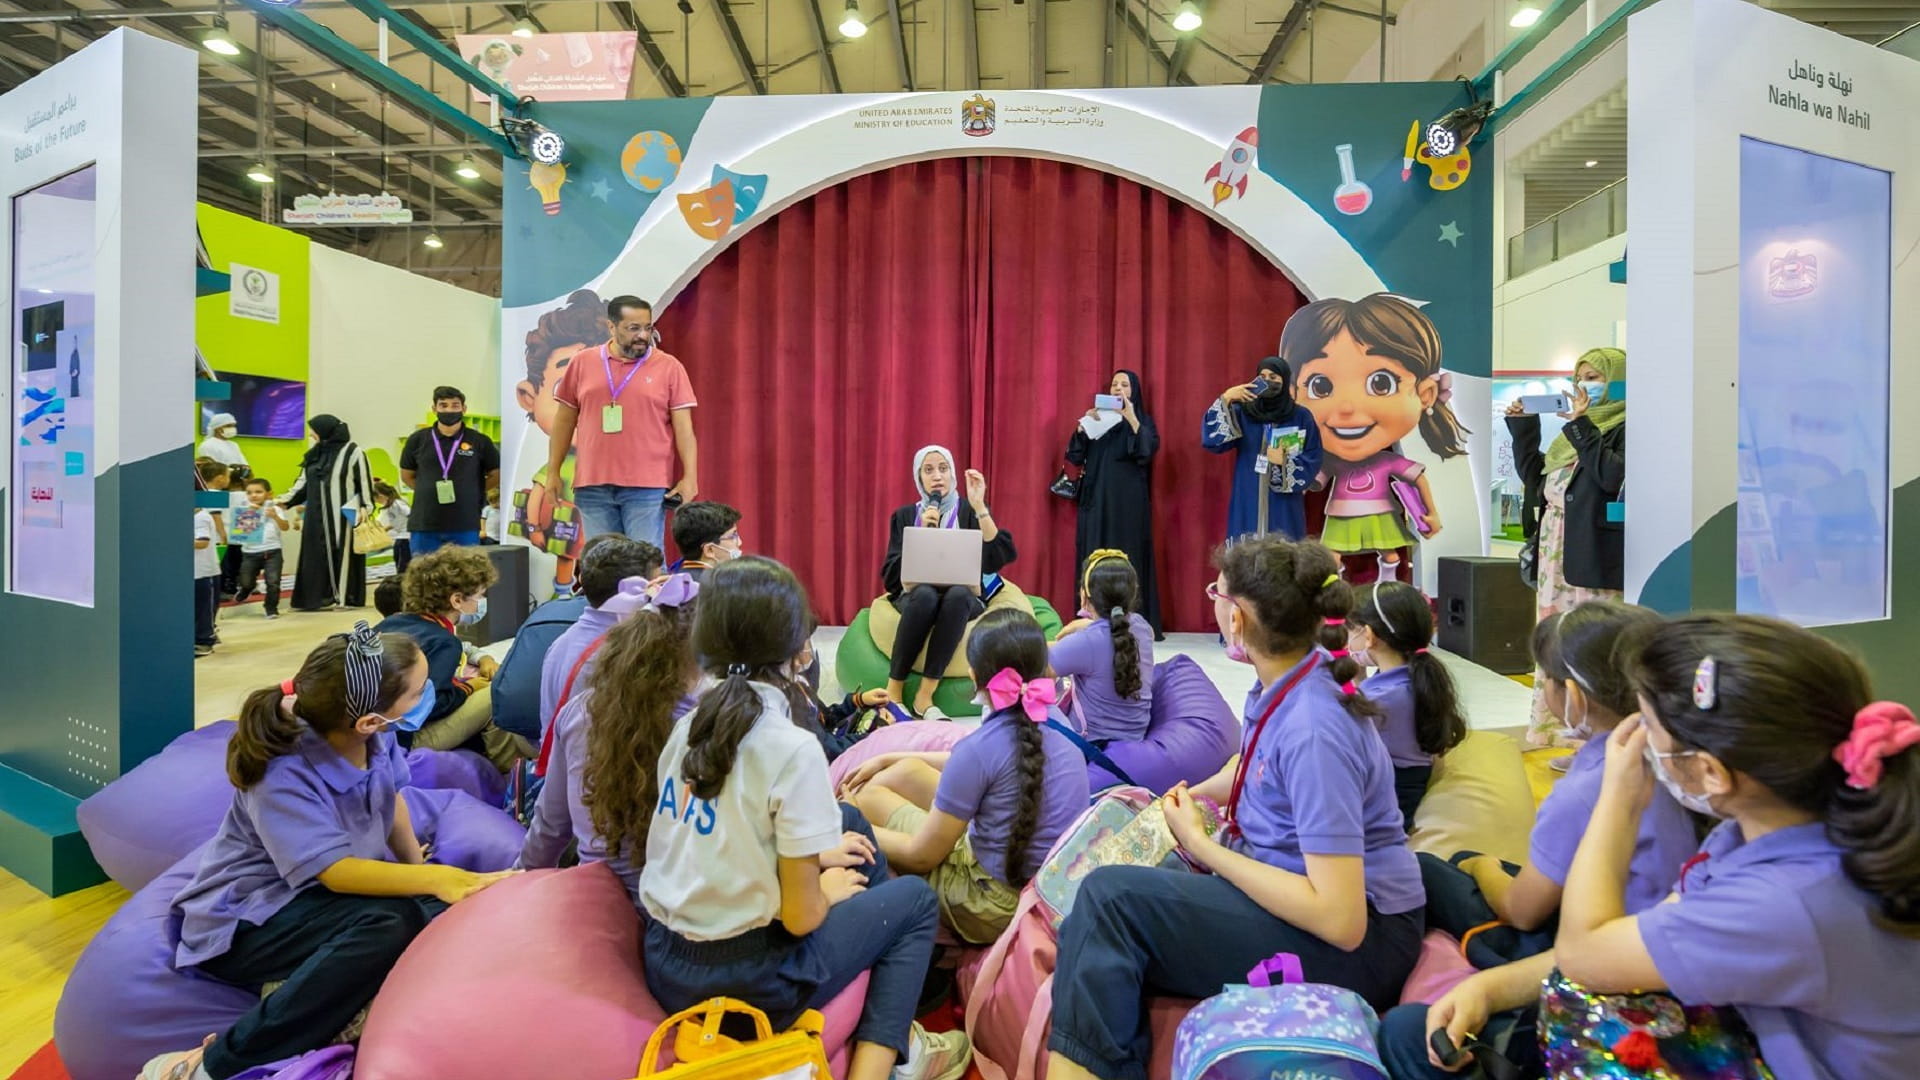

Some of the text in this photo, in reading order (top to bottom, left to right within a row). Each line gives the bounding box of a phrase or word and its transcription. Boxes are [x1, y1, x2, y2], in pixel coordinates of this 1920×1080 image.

[1788, 58, 1852, 96] نهلة وناهل
[854, 118, 953, 129] MINISTRY OF EDUCATION
[859, 106, 953, 118] UNITED ARAB EMIRATES
[1768, 84, 1871, 131] Nahla wa Nahil
[14, 143, 33, 164] Buds
[59, 119, 87, 142] Future
